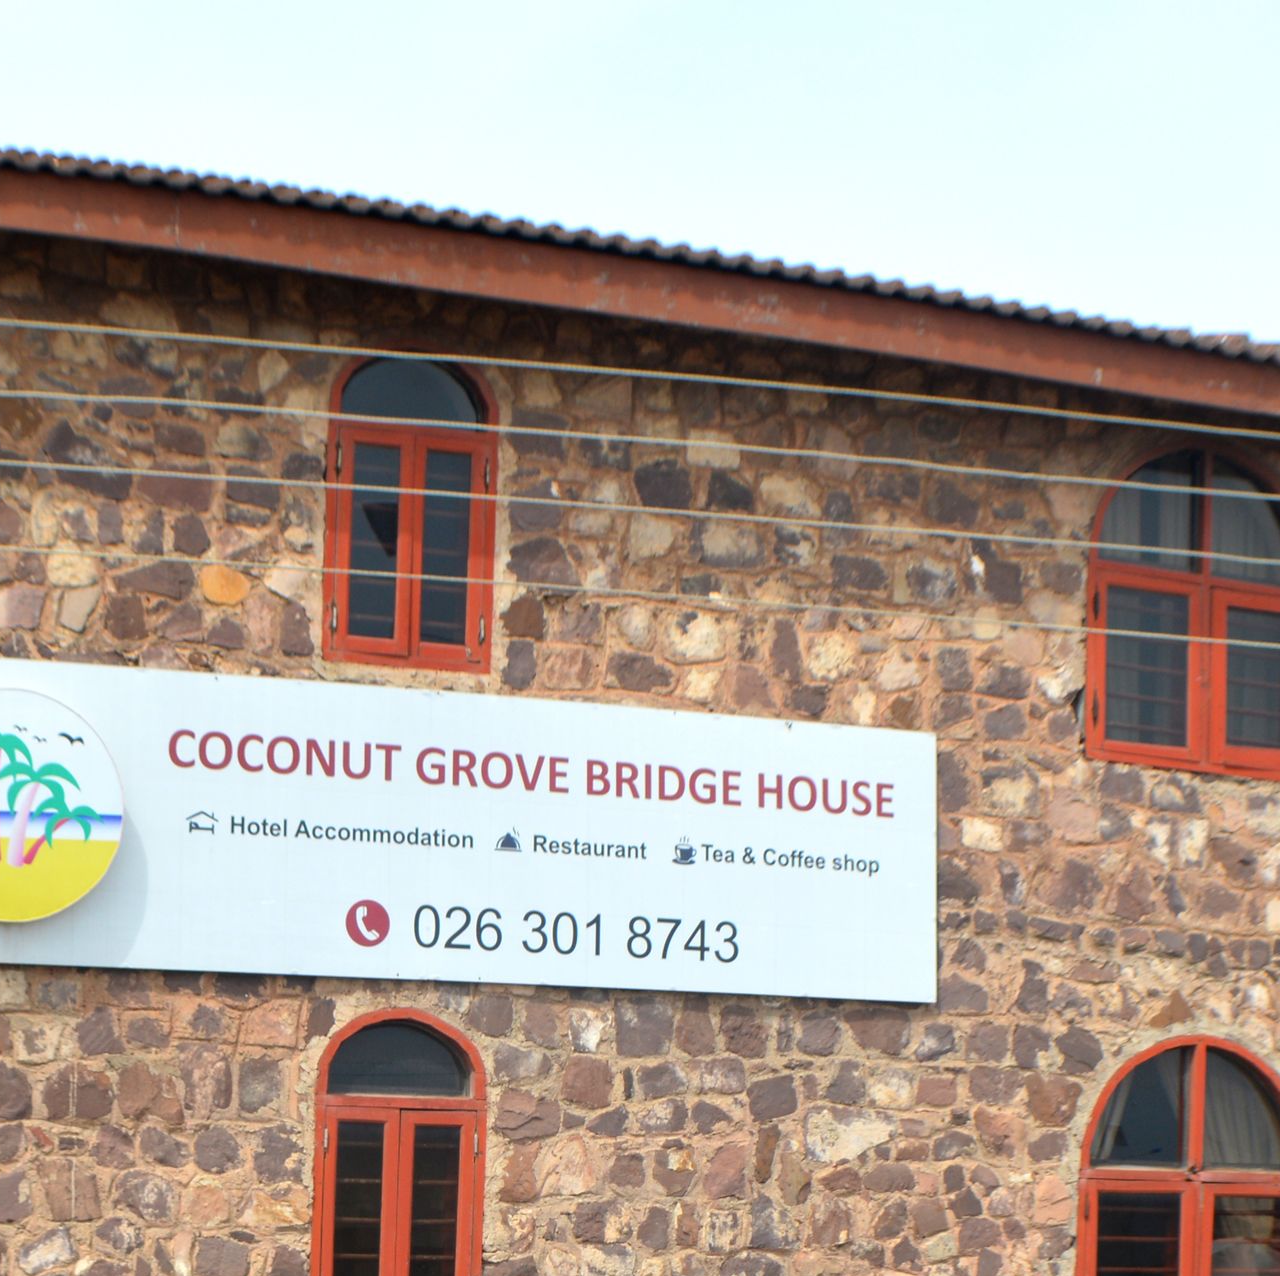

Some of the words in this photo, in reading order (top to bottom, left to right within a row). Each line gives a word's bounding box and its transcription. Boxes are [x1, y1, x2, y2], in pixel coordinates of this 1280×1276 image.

[168, 729, 402, 782] COCONUT
[415, 746, 570, 794] GROVE
[586, 759, 742, 807] BRIDGE
[757, 772, 895, 819] HOUSE
[230, 815, 288, 838] Hotel
[294, 819, 474, 849] Accommodation
[533, 834, 648, 860] Restaurant
[700, 843, 735, 864] Tea
[742, 846, 757, 865] &
[762, 847, 826, 870] Coffee
[832, 853, 881, 878] shop
[413, 904, 503, 952] 026
[521, 909, 602, 957] 301
[626, 915, 740, 964] 8743
